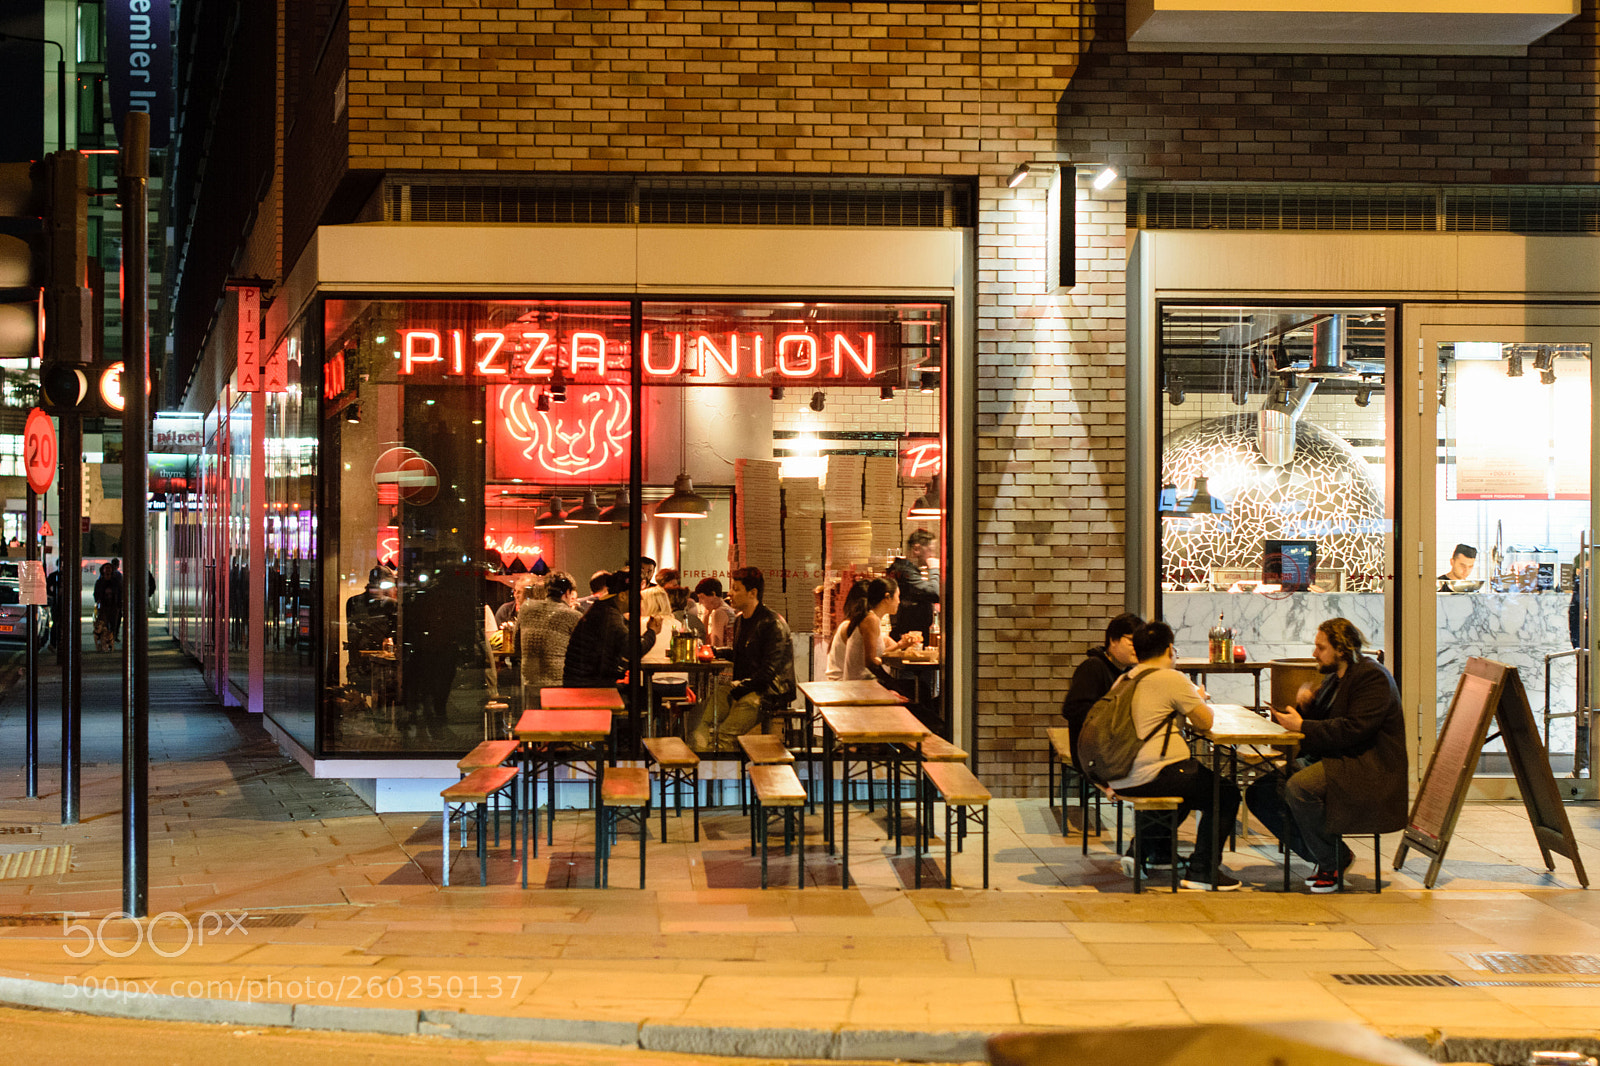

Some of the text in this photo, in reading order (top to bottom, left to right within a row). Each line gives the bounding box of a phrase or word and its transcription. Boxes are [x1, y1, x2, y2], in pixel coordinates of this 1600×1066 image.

[243, 289, 255, 385] PIZZA
[398, 329, 608, 376] PIZZA
[641, 329, 877, 377] UNION
[29, 434, 51, 468] 20
[160, 468, 186, 479] thyme
[769, 570, 799, 579] PIZZA
